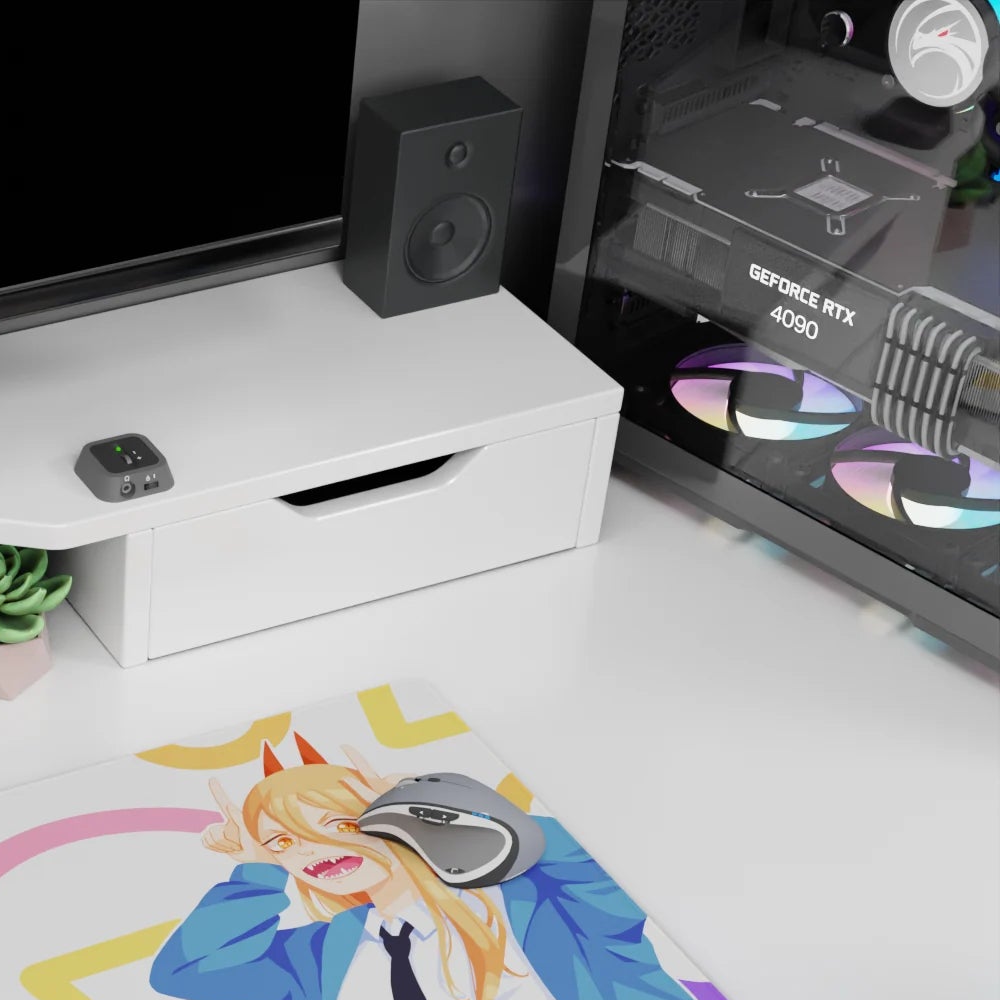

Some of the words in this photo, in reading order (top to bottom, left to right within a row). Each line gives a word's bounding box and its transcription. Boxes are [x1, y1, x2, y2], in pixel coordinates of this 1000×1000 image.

[749, 263, 820, 309] GEFORCE
[822, 298, 856, 327] RTX
[770, 305, 819, 340] 4090
